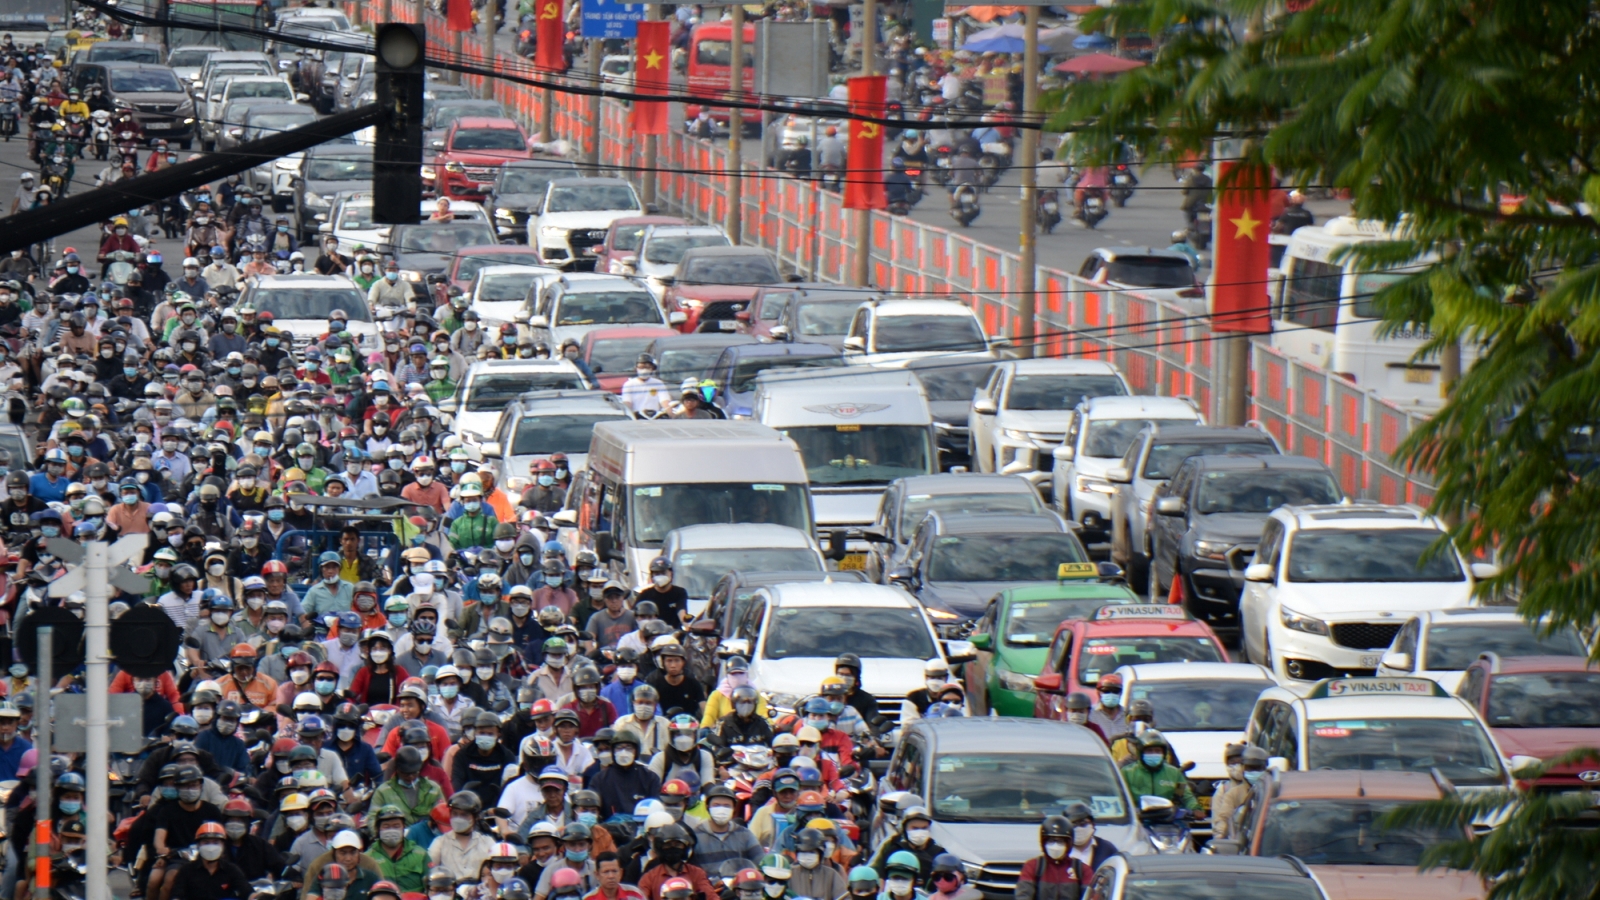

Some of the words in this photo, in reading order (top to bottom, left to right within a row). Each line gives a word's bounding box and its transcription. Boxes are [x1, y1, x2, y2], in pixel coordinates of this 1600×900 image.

[848, 555, 862, 563] 51B
[1350, 682, 1402, 692] VINASUN
[1403, 682, 1426, 692] TAXI
